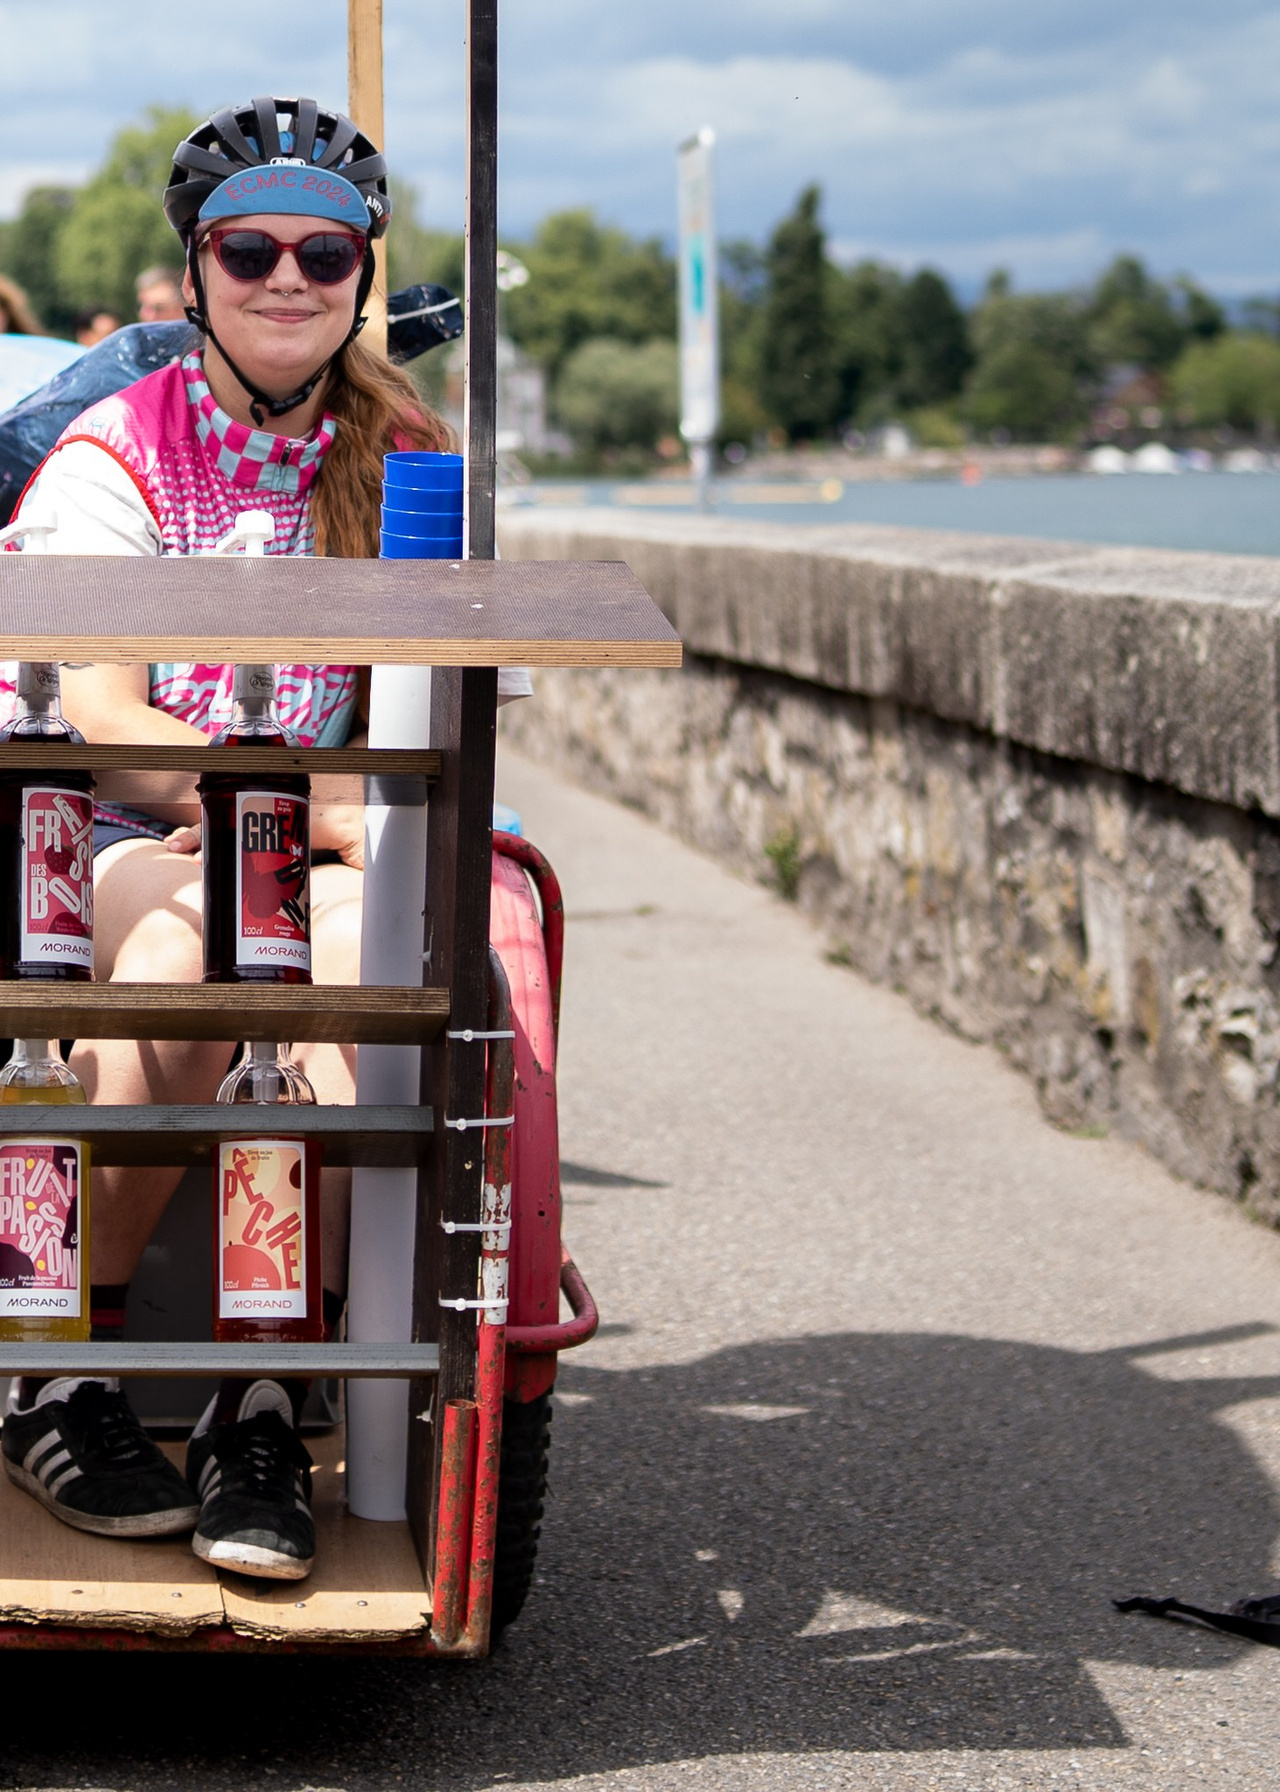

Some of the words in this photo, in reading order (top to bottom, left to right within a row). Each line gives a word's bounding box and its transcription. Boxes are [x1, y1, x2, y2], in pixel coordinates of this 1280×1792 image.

[224, 171, 297, 201] ECMC
[301, 175, 352, 208] 2024
[365, 195, 384, 218] ANTI
[30, 863, 47, 877] DES
[30, 876, 93, 927] BOIS
[244, 926, 263, 936] 100cl
[40, 943, 91, 957] MORAND
[254, 946, 308, 960] MORAND
[0, 1157, 76, 1208] FRUIT
[223, 1147, 302, 1290] PÊCHE
[7, 1297, 68, 1307] MORAND
[232, 1299, 293, 1309] MORAND
